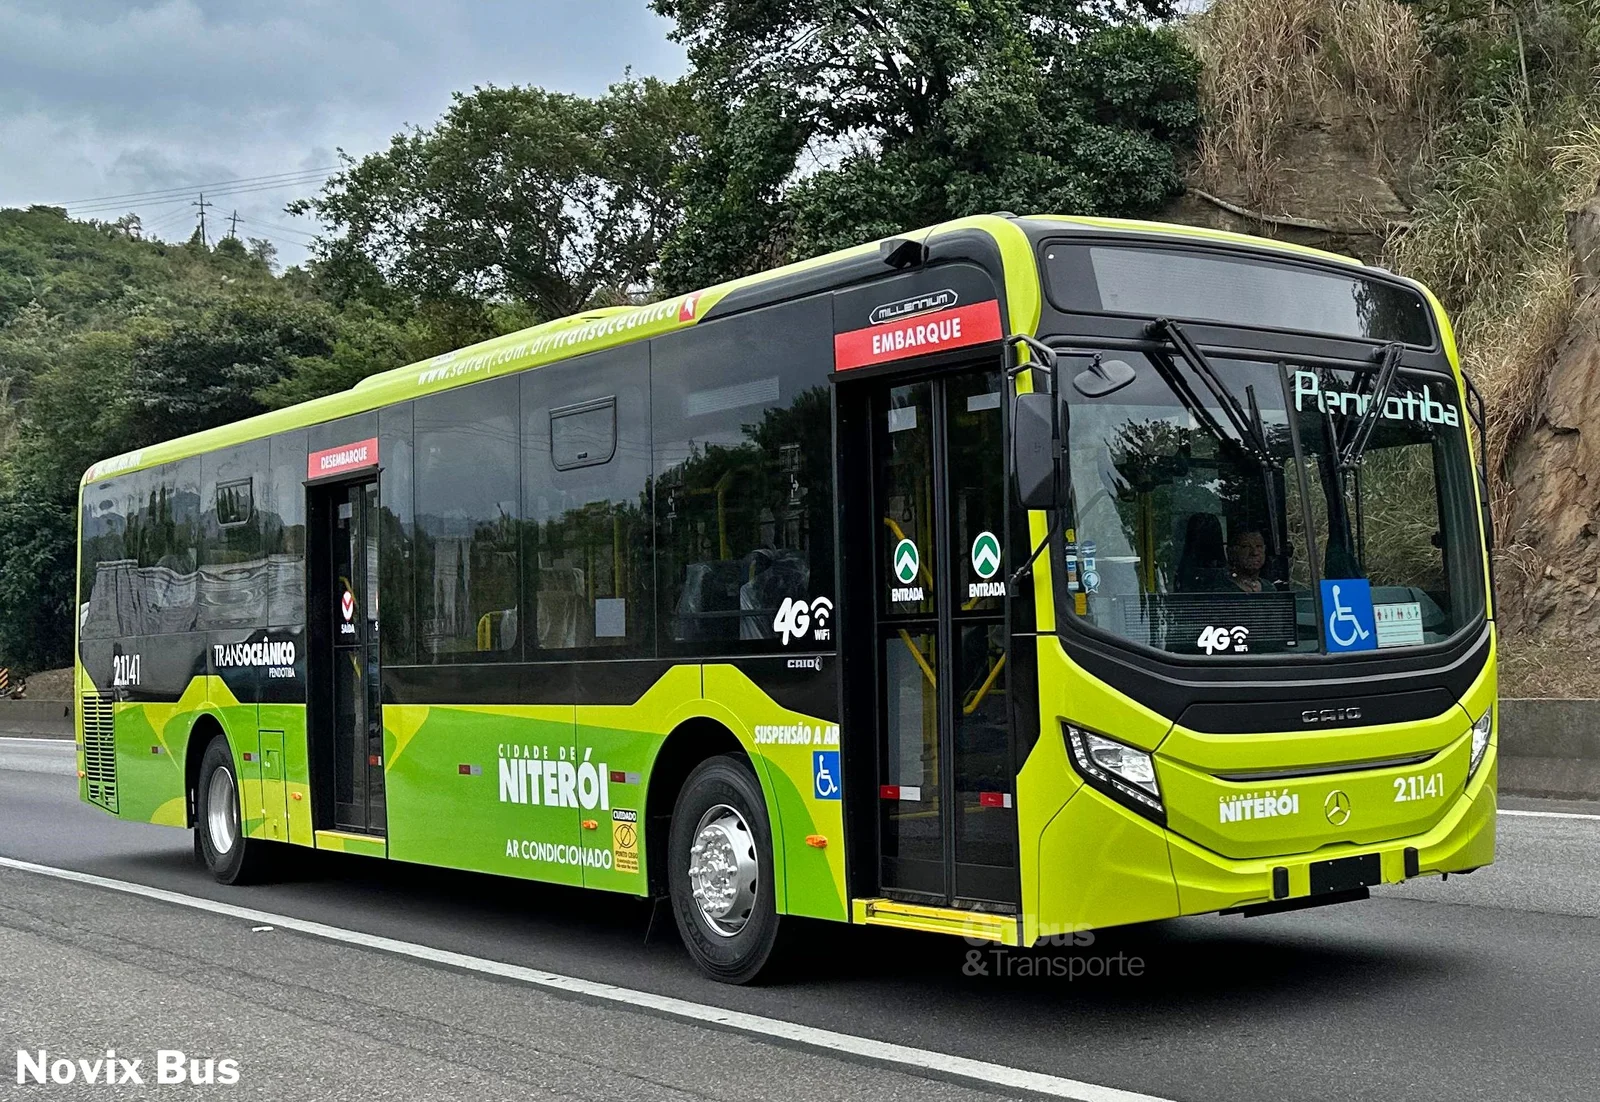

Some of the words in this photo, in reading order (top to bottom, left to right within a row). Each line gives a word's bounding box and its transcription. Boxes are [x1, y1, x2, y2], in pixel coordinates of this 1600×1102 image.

[878, 293, 948, 319] MILLENNIUM
[872, 317, 962, 355] EMBARQUE
[320, 446, 368, 470] DESEMBARQUE
[891, 586, 924, 602] ENTRADA
[968, 582, 1006, 598] ENTRADA
[773, 597, 811, 646] 4G
[213, 635, 296, 667] TRANSOCEÂNICO
[1197, 625, 1231, 656] 4G
[268, 667, 296, 679] PENDOTIBA
[787, 659, 815, 668] CAIO
[1301, 707, 1362, 723] CAIO
[754, 721, 812, 745] SUSPENSÃO
[813, 725, 822, 745] A
[823, 725, 840, 745] AR
[498, 743, 548, 760] CIDADE
[560, 746, 576, 760] DE
[498, 747, 610, 811] NITERÓI
[1218, 792, 1259, 803] CIDADE
[1219, 788, 1299, 824] NITERÓI
[613, 811, 636, 821] CUIDADO
[505, 838, 520, 858] AR
[521, 840, 613, 870] CONDICIONADO
